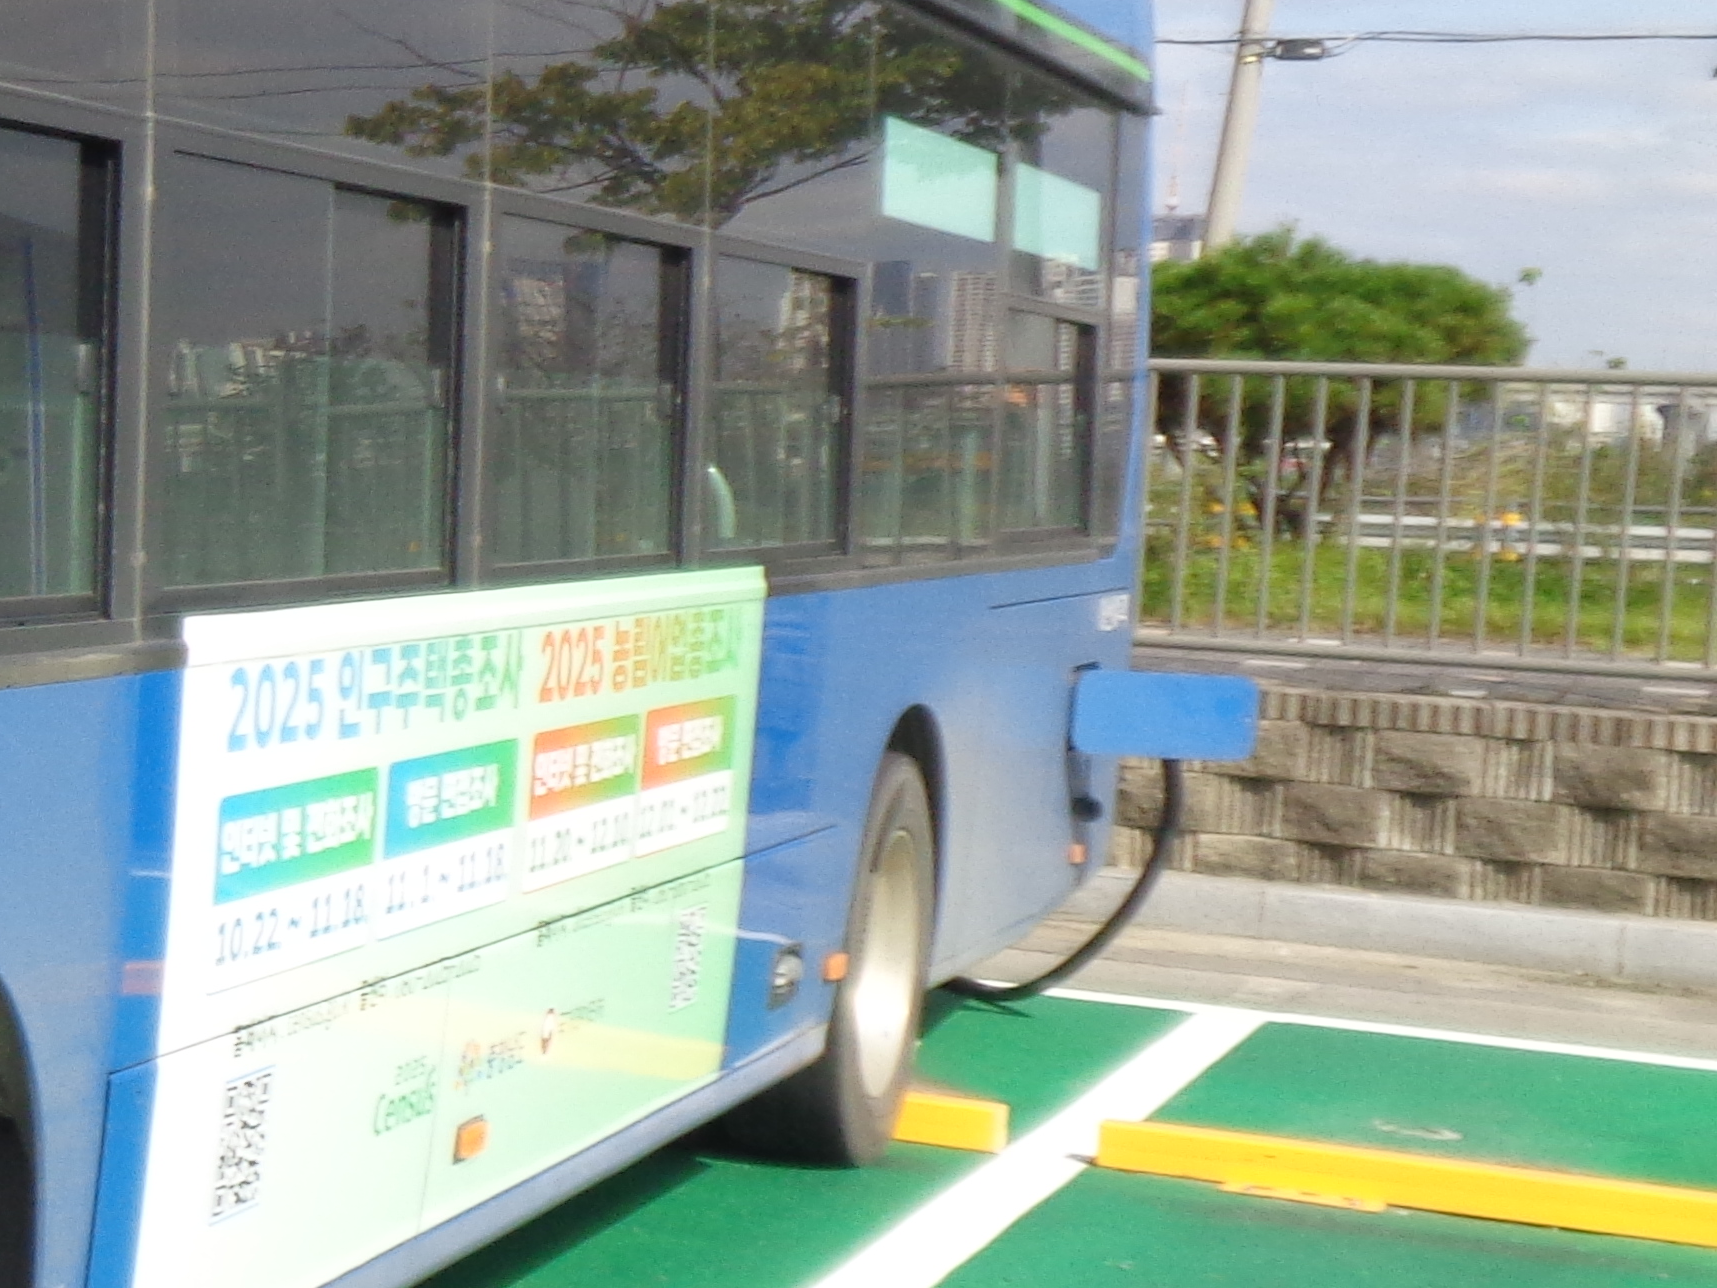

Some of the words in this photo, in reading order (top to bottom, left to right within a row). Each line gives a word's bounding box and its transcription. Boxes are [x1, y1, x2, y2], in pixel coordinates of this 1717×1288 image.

[227, 658, 325, 753] 2025
[338, 629, 524, 740] 인구주택총조사
[538, 625, 606, 704] 2025
